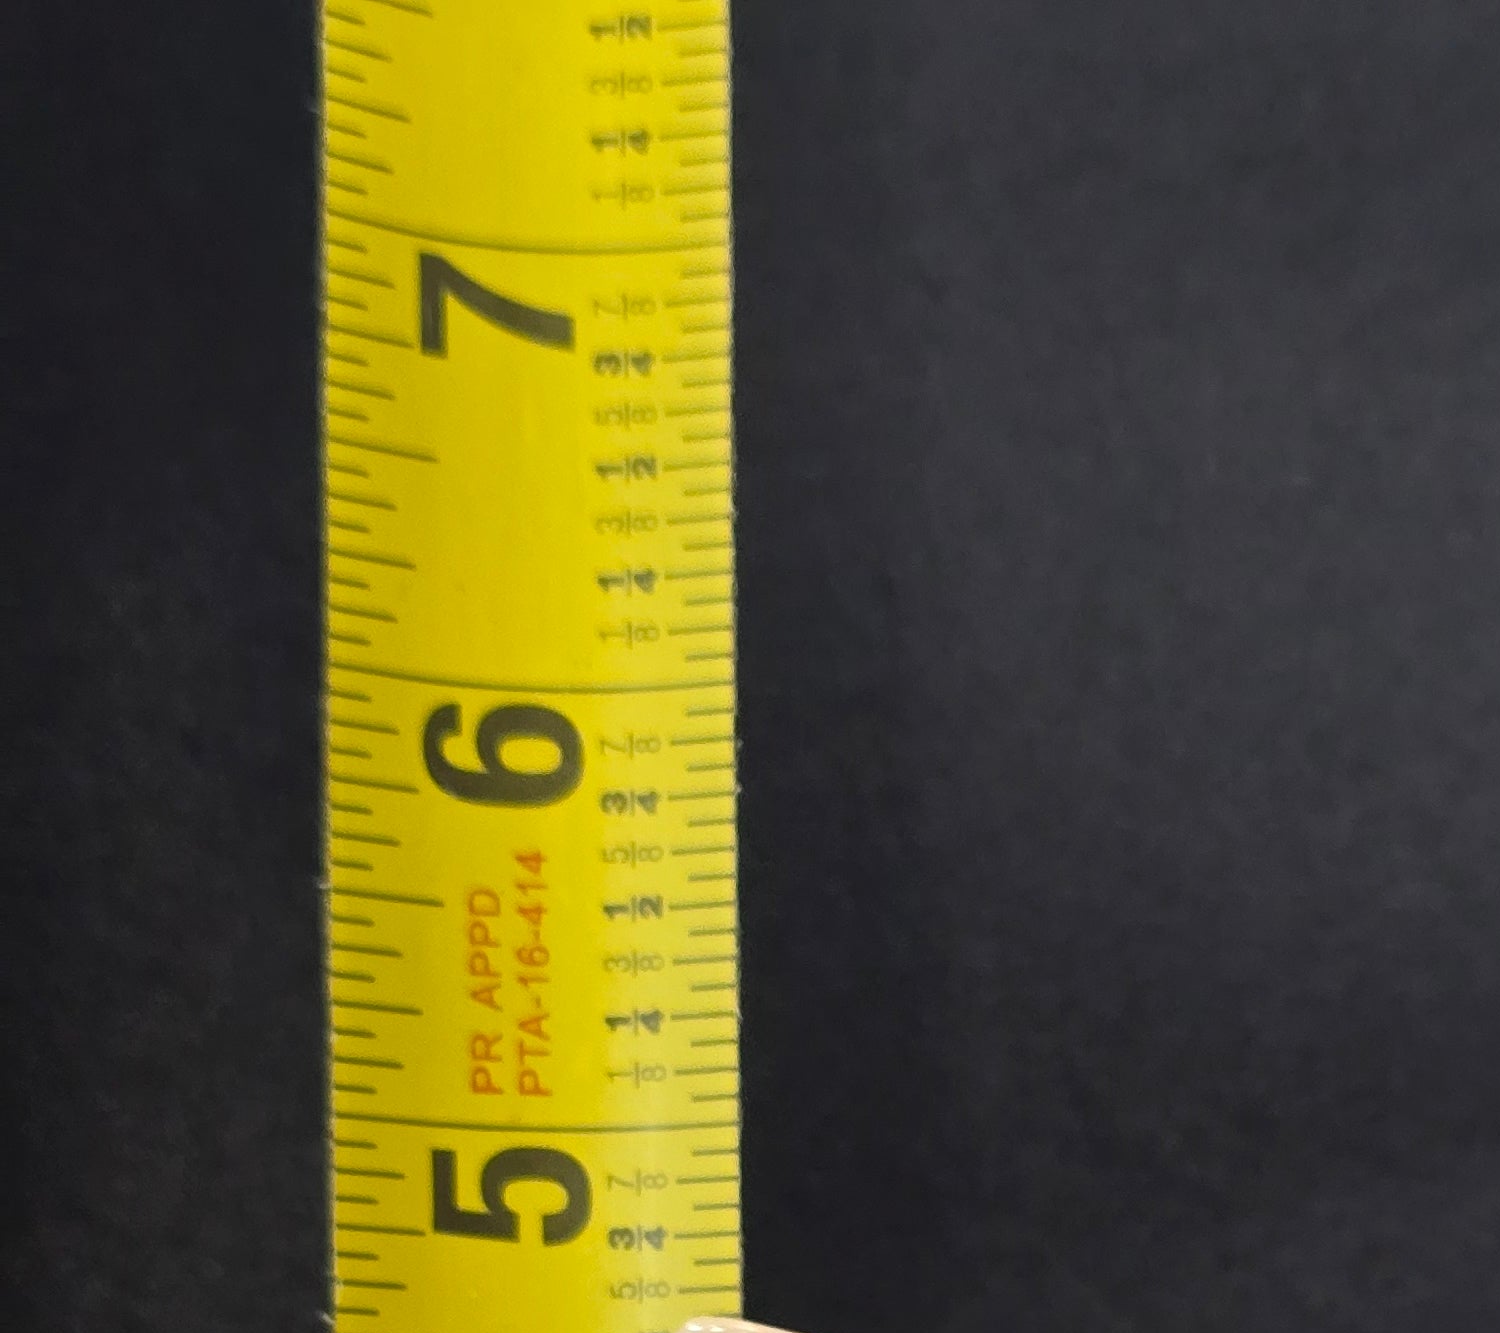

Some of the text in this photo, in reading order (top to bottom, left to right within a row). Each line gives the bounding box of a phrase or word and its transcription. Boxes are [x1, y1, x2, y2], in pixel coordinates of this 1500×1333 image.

[418, 251, 577, 360] 7
[421, 702, 586, 809] 6
[467, 886, 505, 1097] PR APPD
[513, 848, 554, 1098] PTA-16-414
[430, 1144, 594, 1248] 5
